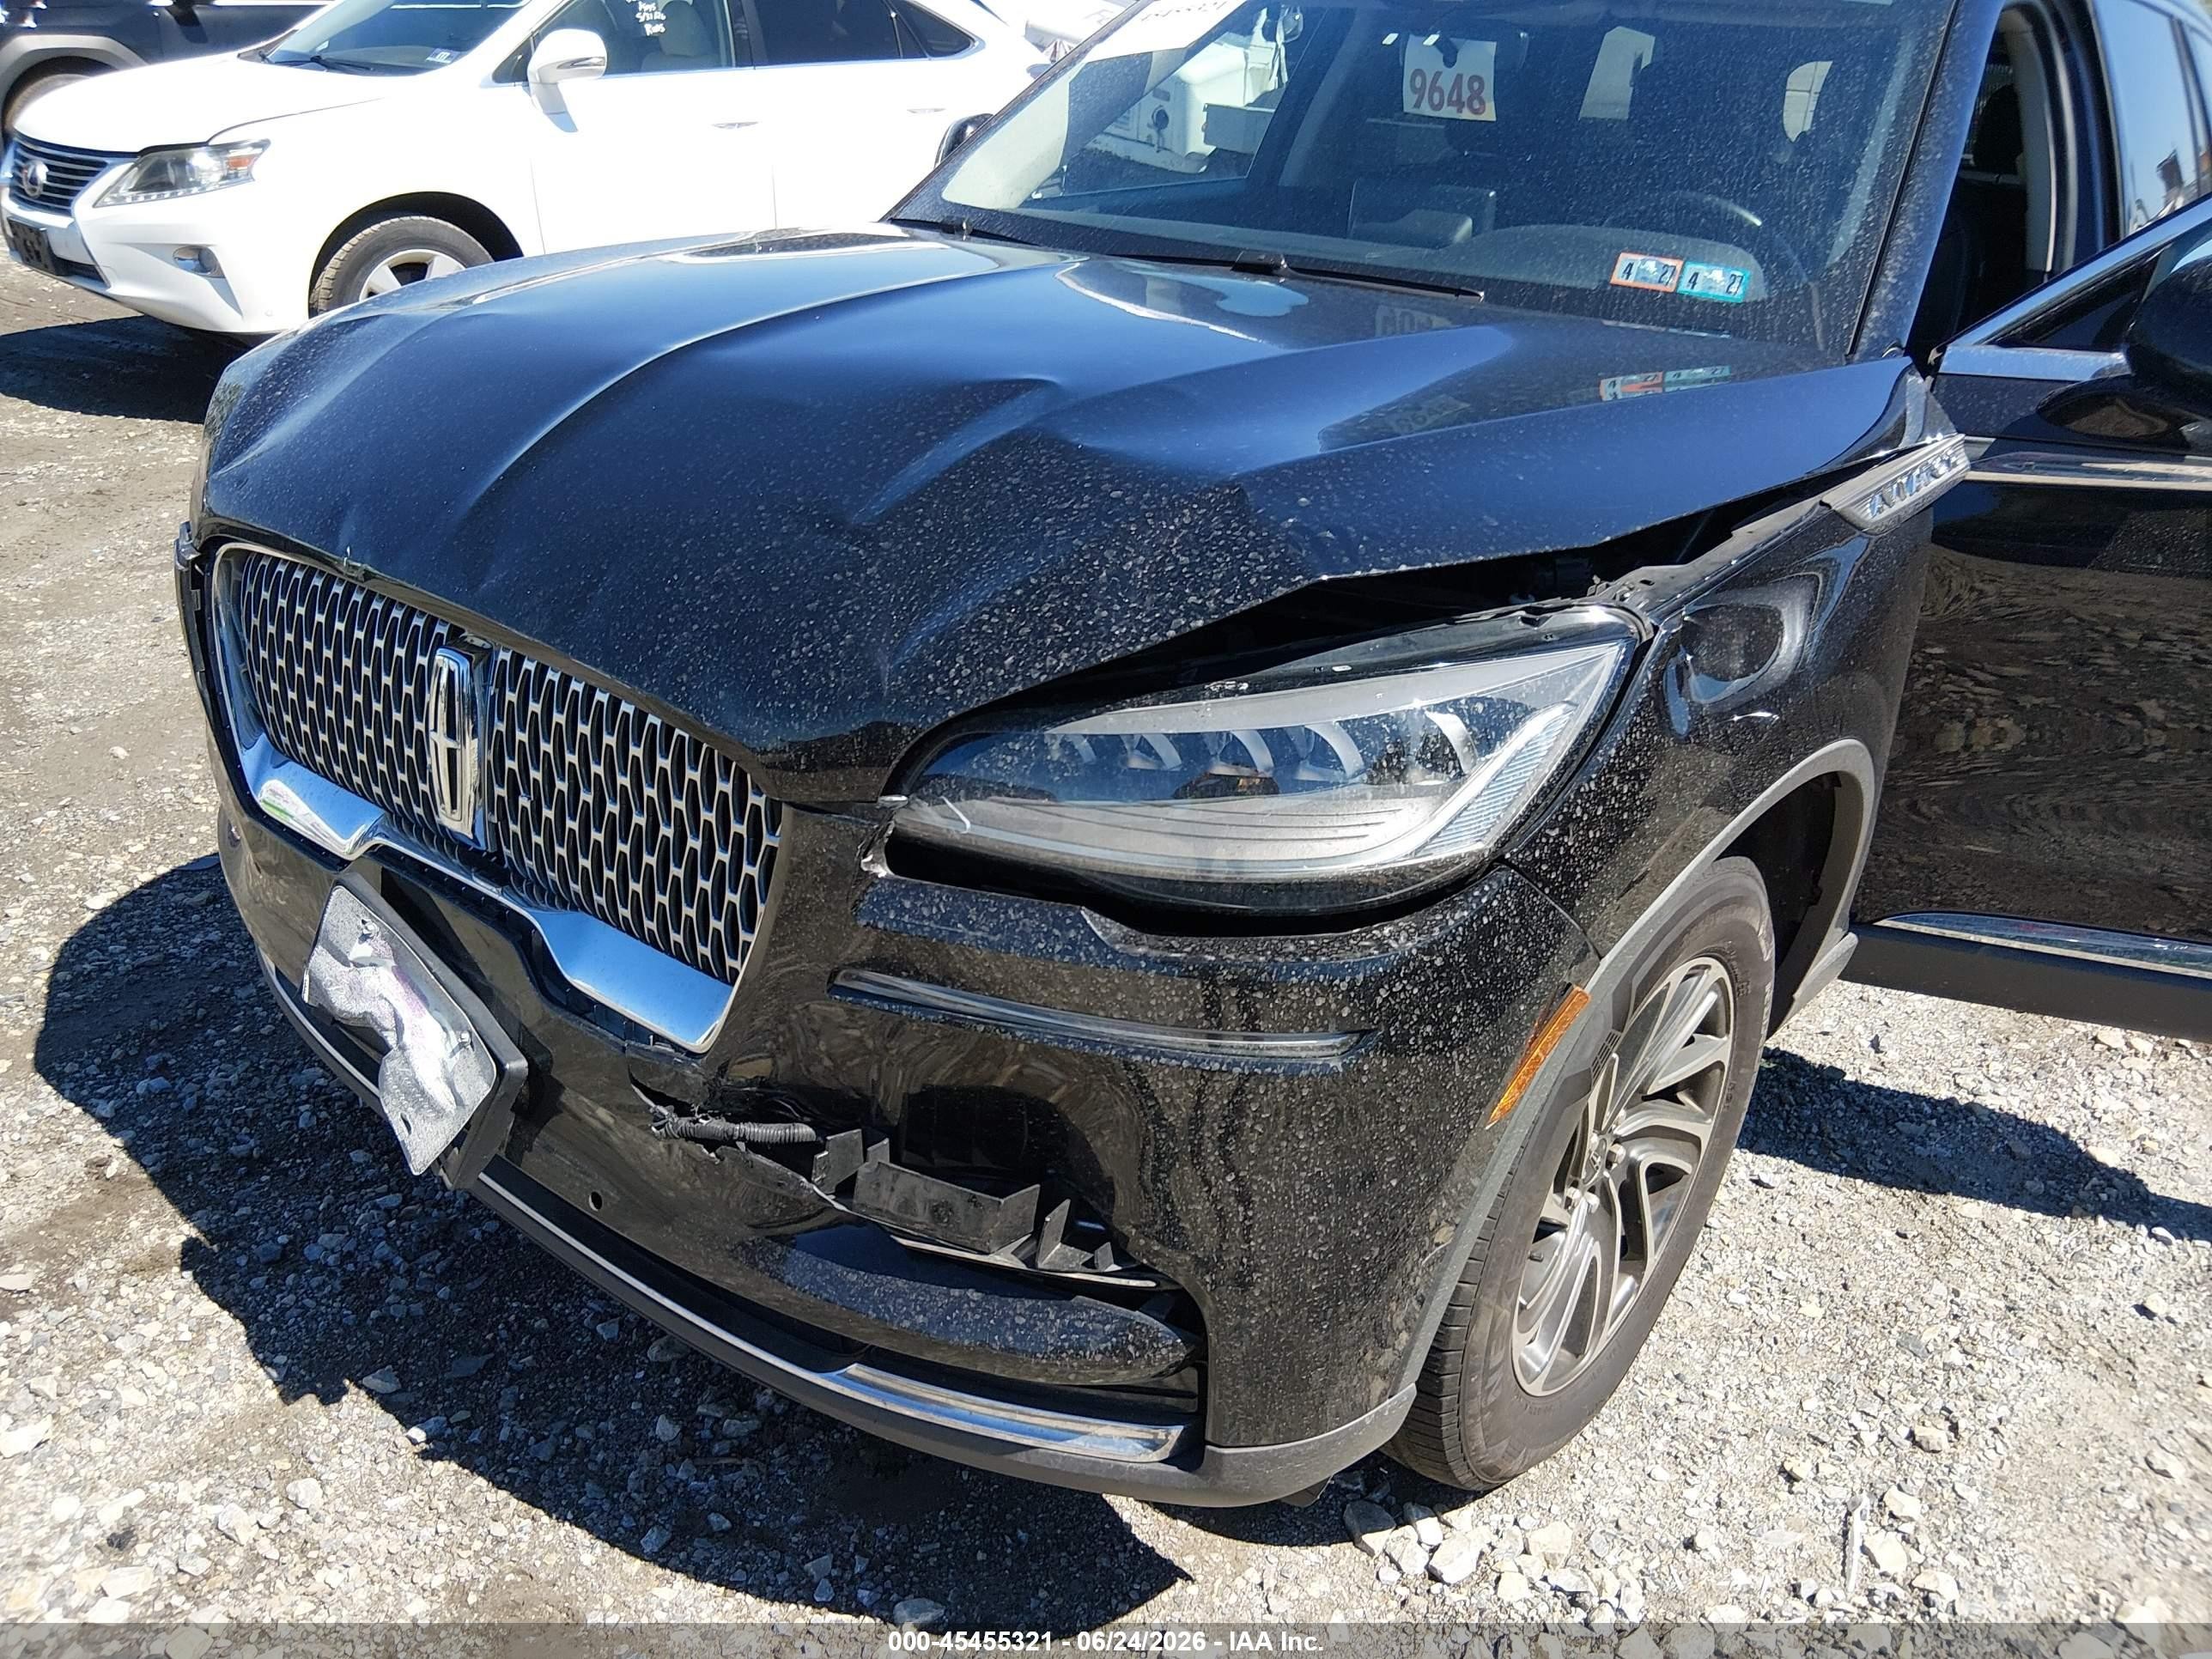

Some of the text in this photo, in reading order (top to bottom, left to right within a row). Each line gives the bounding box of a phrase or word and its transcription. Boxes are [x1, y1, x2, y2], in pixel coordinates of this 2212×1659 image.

[1409, 68, 1486, 116] 9648
[1622, 261, 1677, 287] 4 27
[1687, 271, 1744, 296] 4 27
